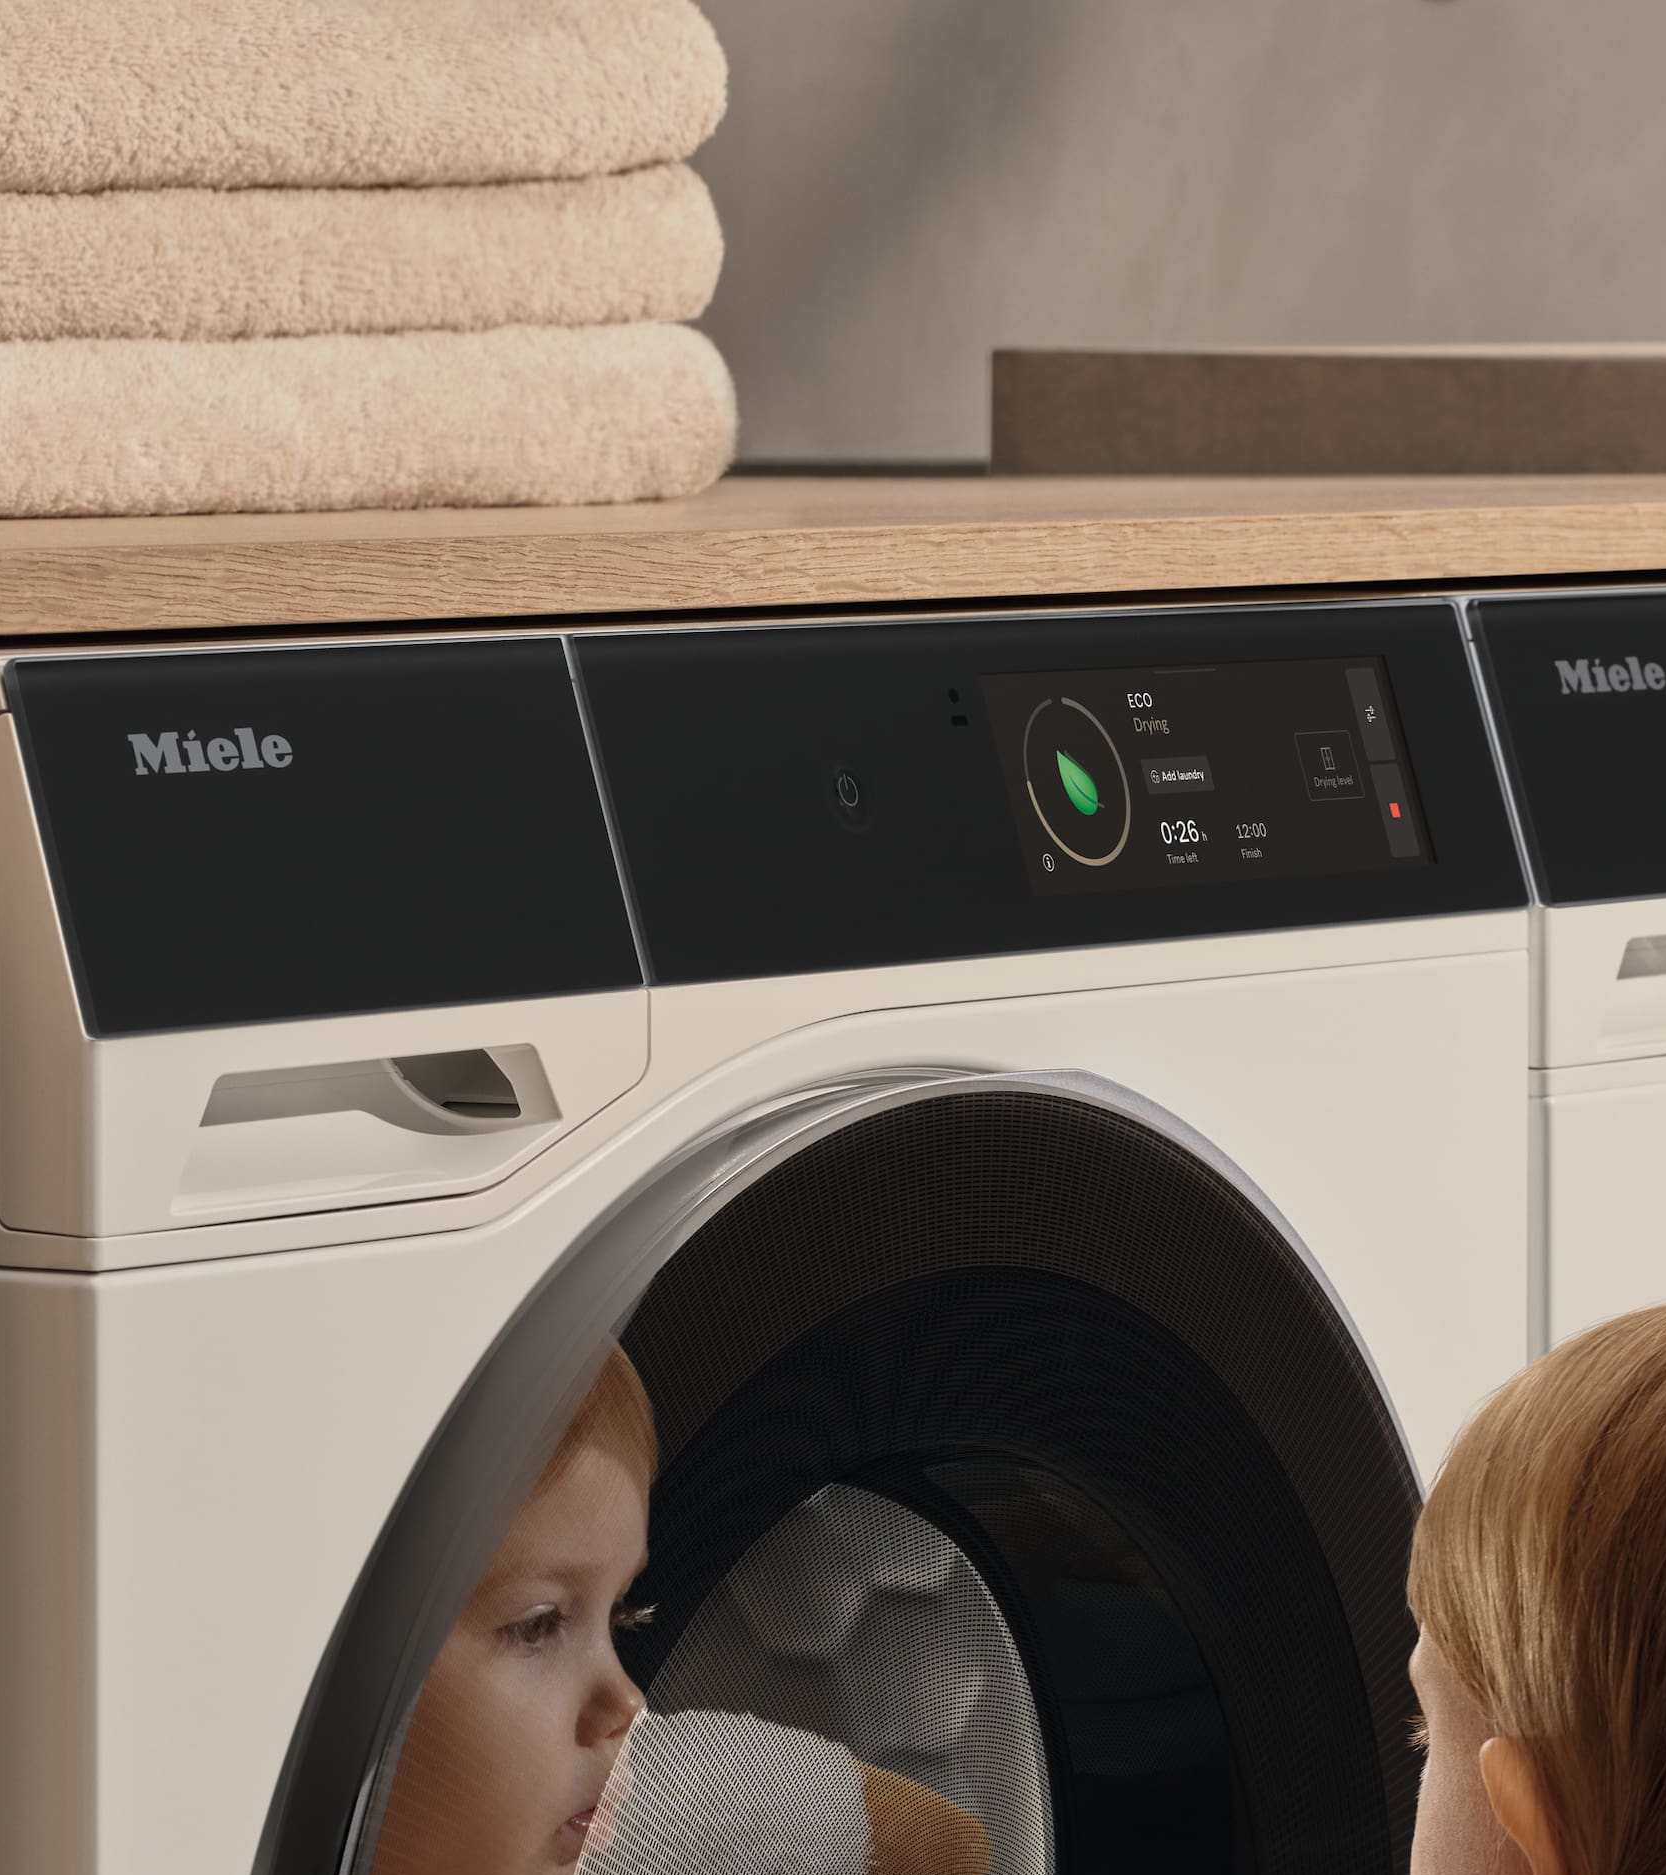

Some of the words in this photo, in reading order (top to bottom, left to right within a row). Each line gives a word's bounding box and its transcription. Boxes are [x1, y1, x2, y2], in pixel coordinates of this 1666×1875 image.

[1554, 656, 1666, 695] Miele
[1126, 692, 1153, 708] ECO
[1133, 716, 1170, 735] Drying
[127, 727, 293, 775] Miele
[1161, 769, 1177, 782] Add
[1176, 769, 1205, 782] laundry
[1313, 776, 1338, 789] Drying
[1160, 819, 1200, 844] 0:26
[1235, 822, 1267, 839] 12:00
[1166, 853, 1186, 864] Time
[1185, 851, 1199, 863] left
[1240, 848, 1263, 859] Finish
